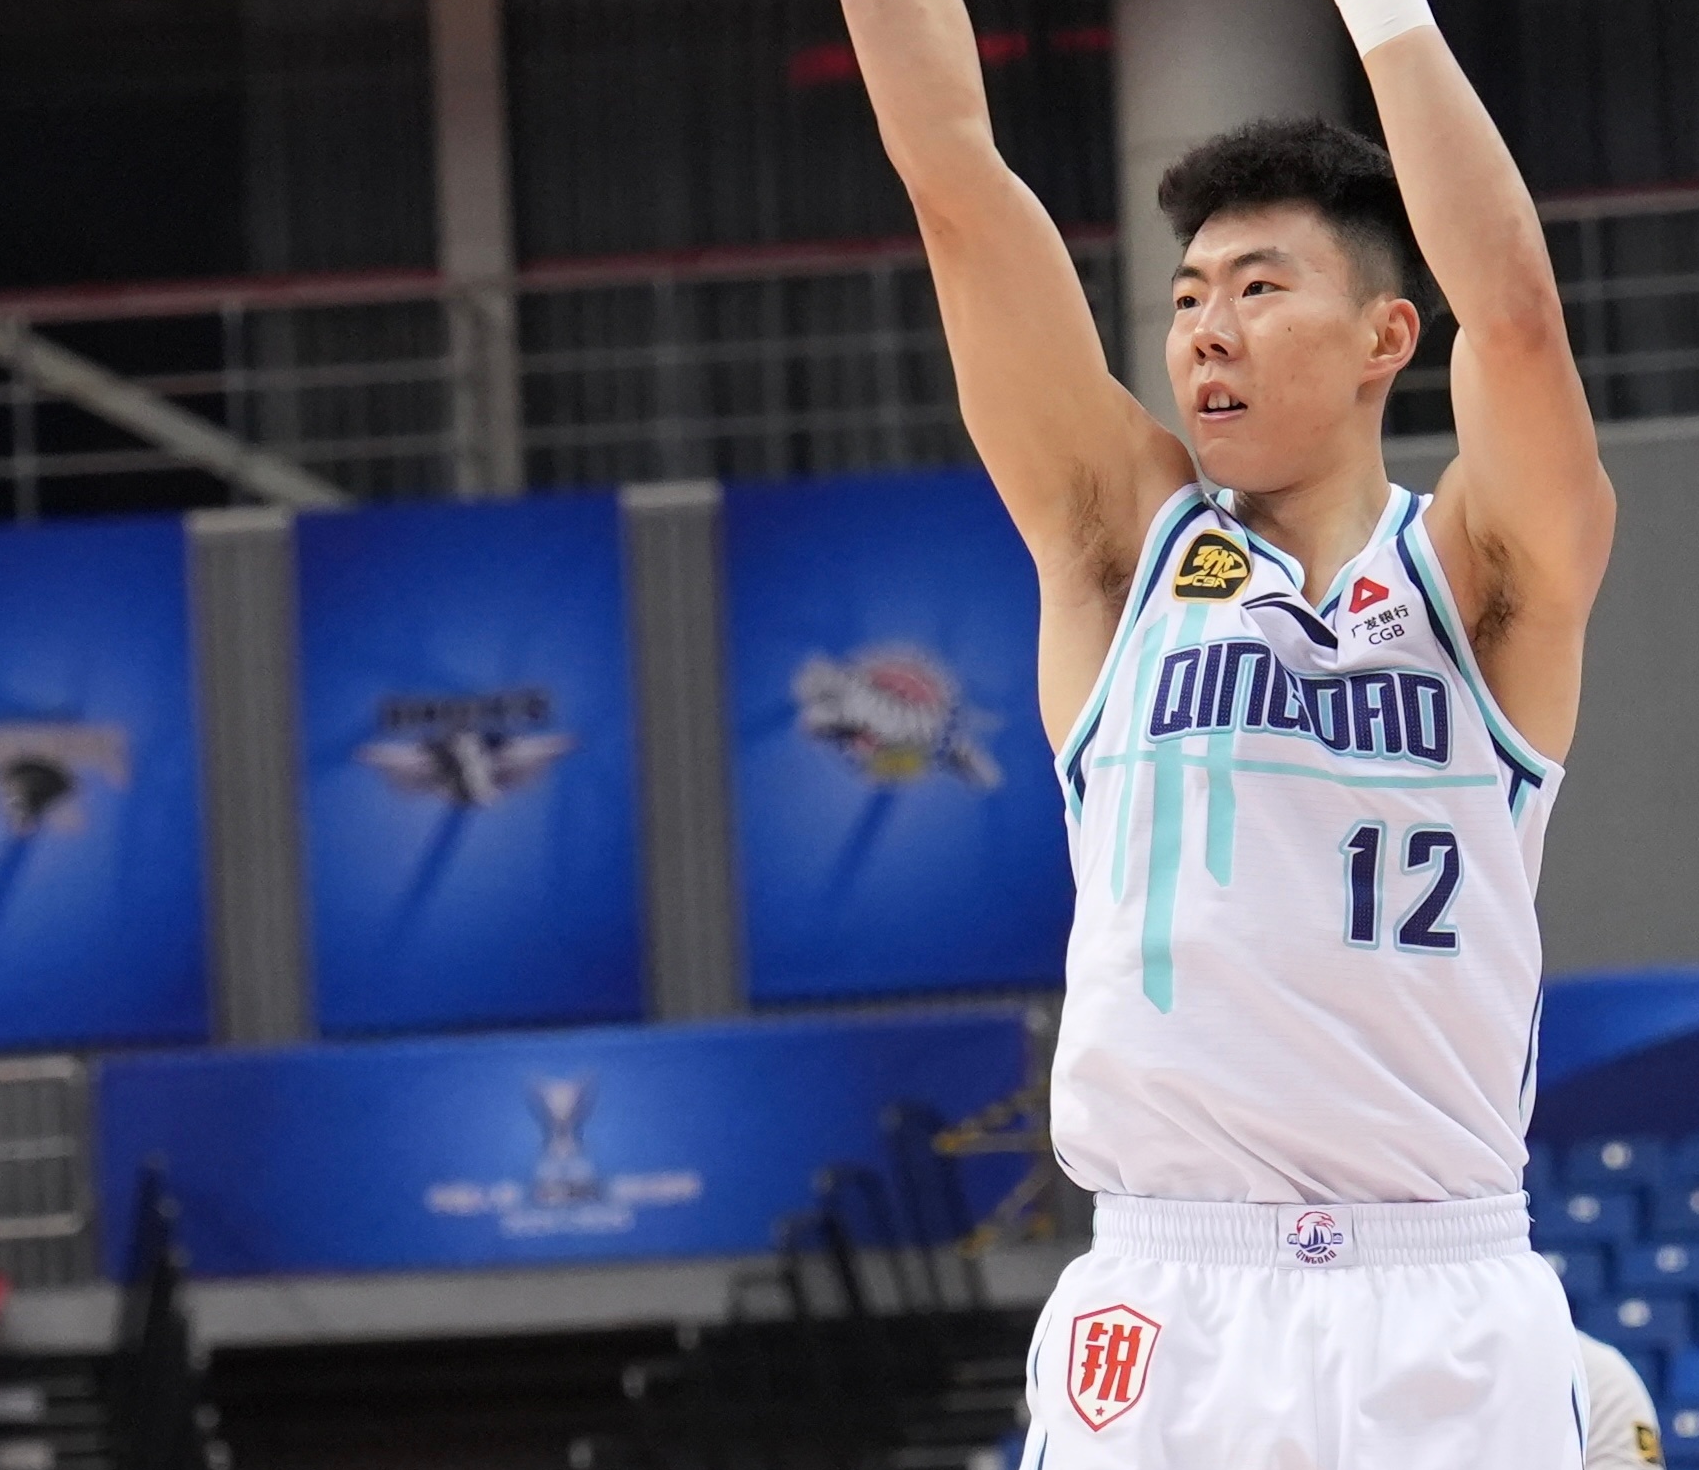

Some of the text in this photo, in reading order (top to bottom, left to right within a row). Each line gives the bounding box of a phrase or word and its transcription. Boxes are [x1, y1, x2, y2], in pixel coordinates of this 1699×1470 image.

[1192, 575, 1227, 589] CBA
[1351, 604, 1409, 638] 广发银行
[1368, 623, 1405, 645] CGB
[1148, 638, 1452, 768] QINGDAO
[1344, 824, 1462, 952] 12
[1295, 1249, 1337, 1265] QINGDAO
[1078, 1321, 1143, 1403] 锐
